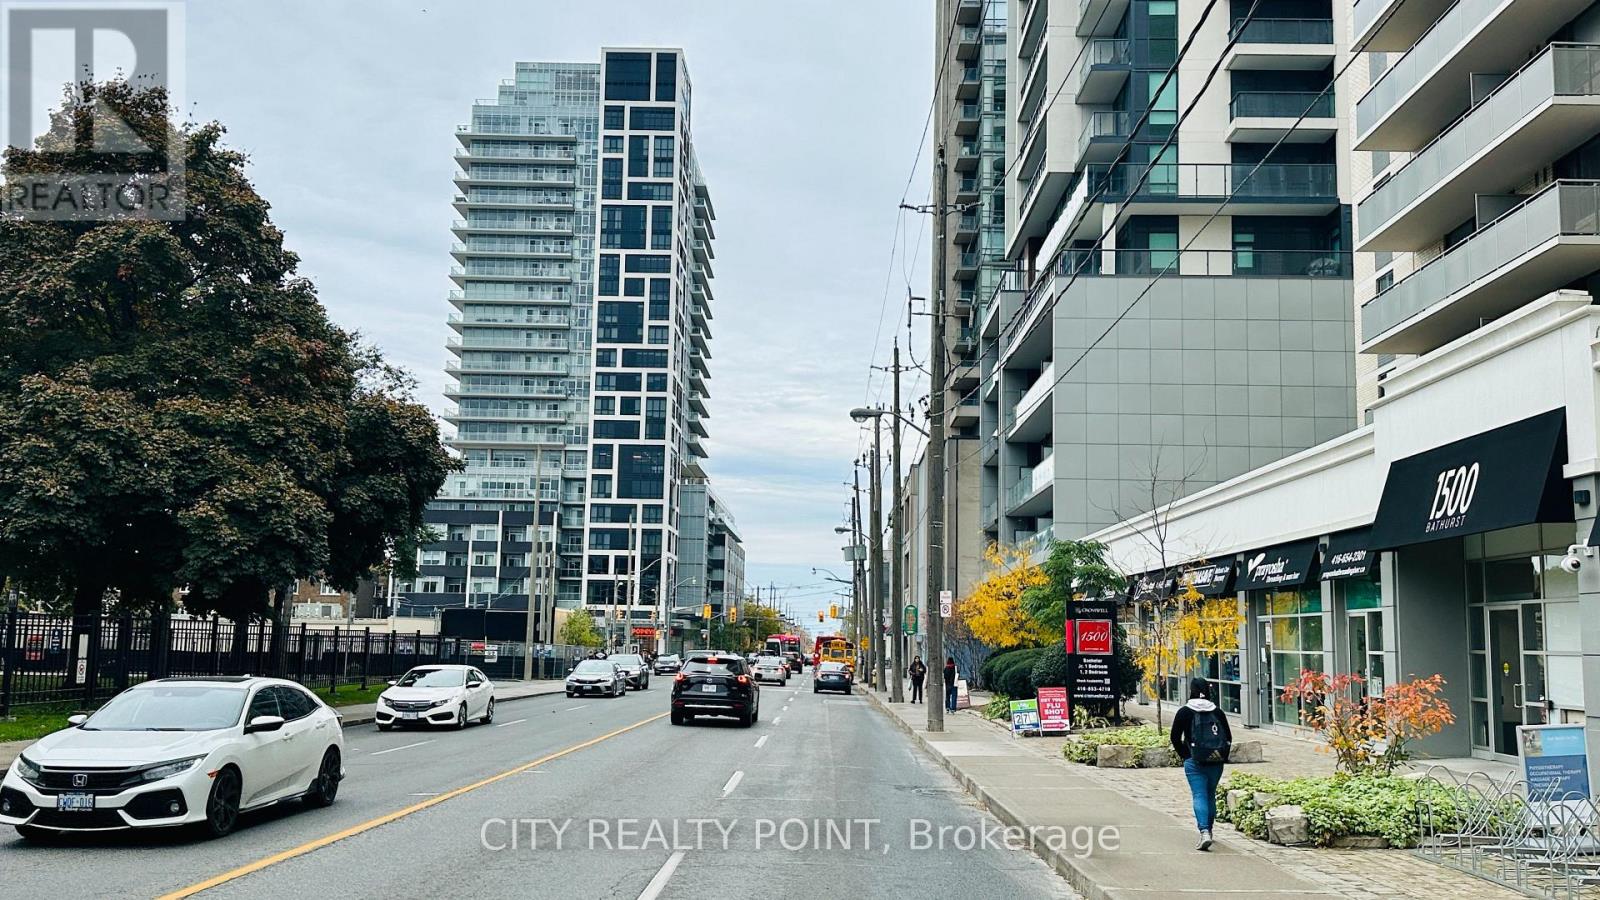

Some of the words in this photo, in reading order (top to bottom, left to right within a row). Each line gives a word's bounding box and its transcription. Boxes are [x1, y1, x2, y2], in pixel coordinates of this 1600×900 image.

[1429, 462, 1480, 520] 1500
[1425, 514, 1467, 533] BATHURST
[1081, 631, 1108, 641] 1500
